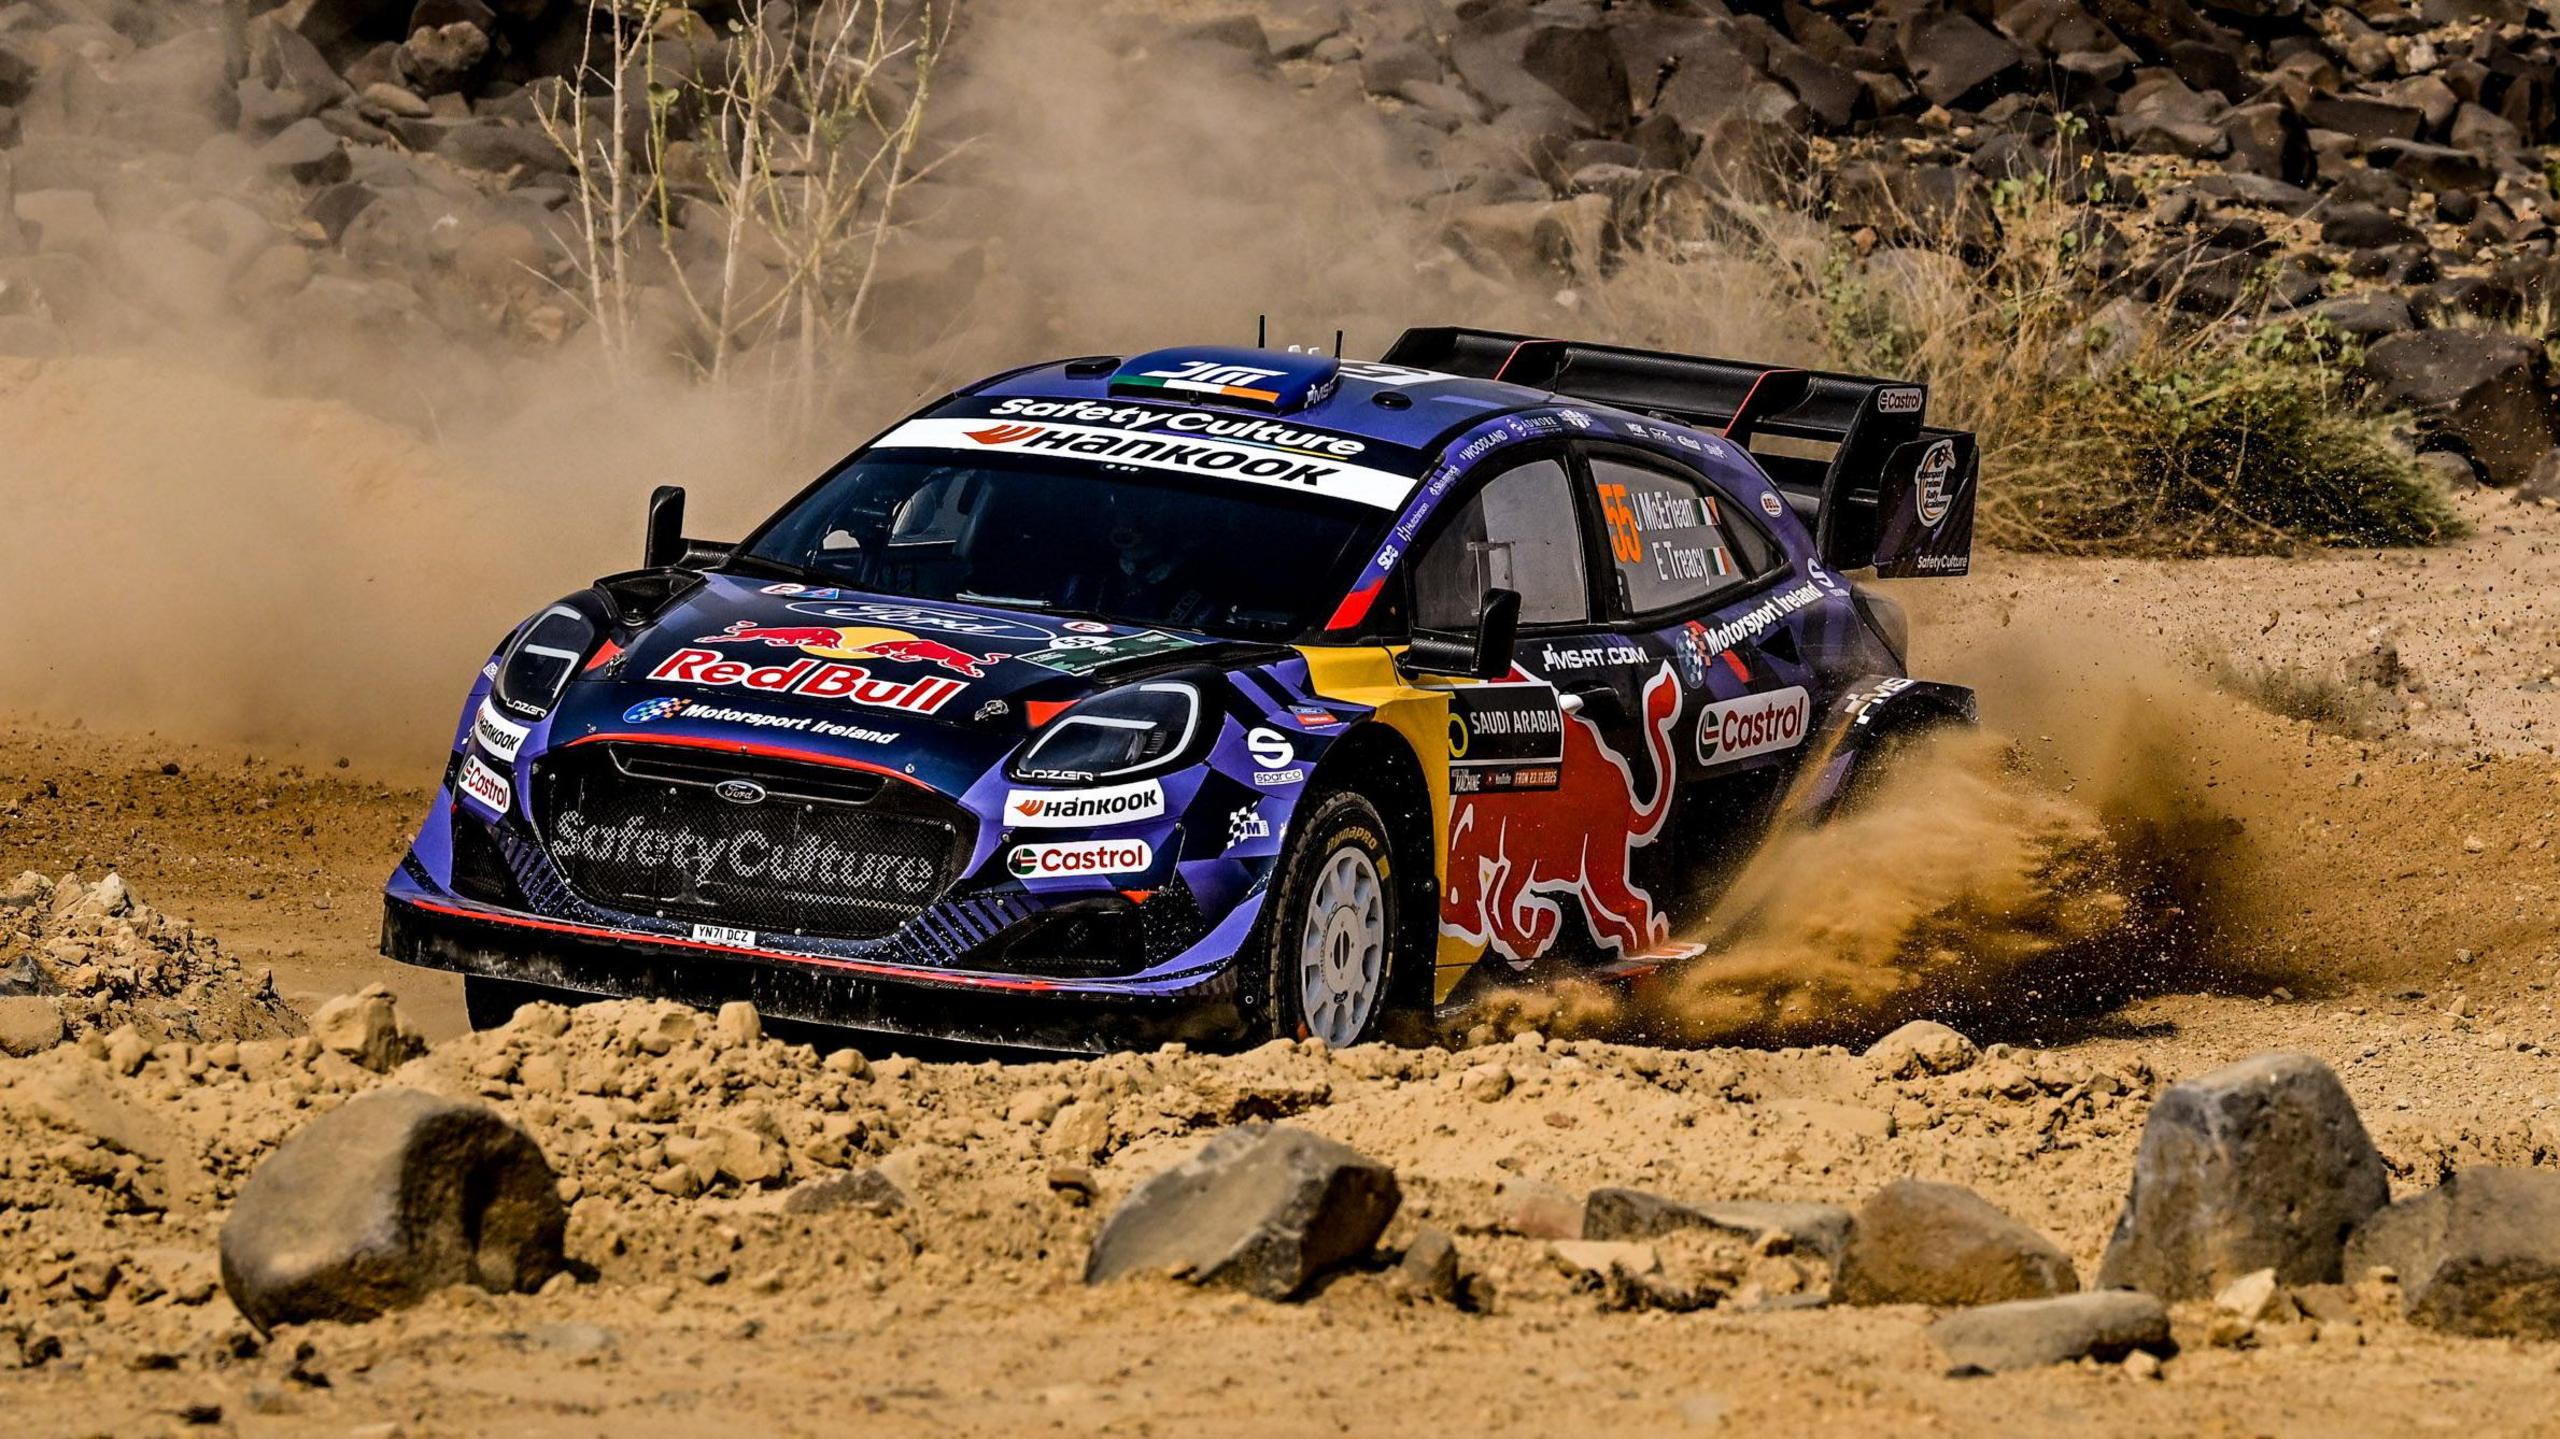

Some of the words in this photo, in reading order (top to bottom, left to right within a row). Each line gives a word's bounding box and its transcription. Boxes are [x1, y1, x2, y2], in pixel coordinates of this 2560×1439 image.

[1887, 391, 1920, 409] Castrol
[990, 397, 1366, 458] SafetyCulture
[1599, 483, 1643, 564] 55
[1631, 492, 1642, 532] J
[1639, 491, 1697, 532] McErlean
[1652, 542, 1668, 581] E
[1664, 541, 1711, 586] Treacy
[1917, 555, 1968, 571] SafetyCulture
[825, 605, 1016, 633] Ford
[1703, 599, 1783, 656] Motorsport
[1773, 579, 1824, 619] Ireland
[1057, 637, 1093, 647] 55
[680, 703, 807, 730] Motorsport
[810, 720, 899, 745] Ireland
[1470, 711, 1510, 735] SAUDI
[1513, 709, 1560, 734] ARABIA
[1722, 696, 1804, 753] Castrol
[468, 766, 507, 807] Castrol
[1016, 769, 1094, 781] LAZER
[1255, 770, 1301, 782] sparco
[724, 783, 754, 800] Ford
[551, 810, 934, 894] SafetyCulture
[1041, 845, 1143, 872] Castrol
[699, 925, 723, 940] YN71
[726, 928, 749, 943] DCZ
